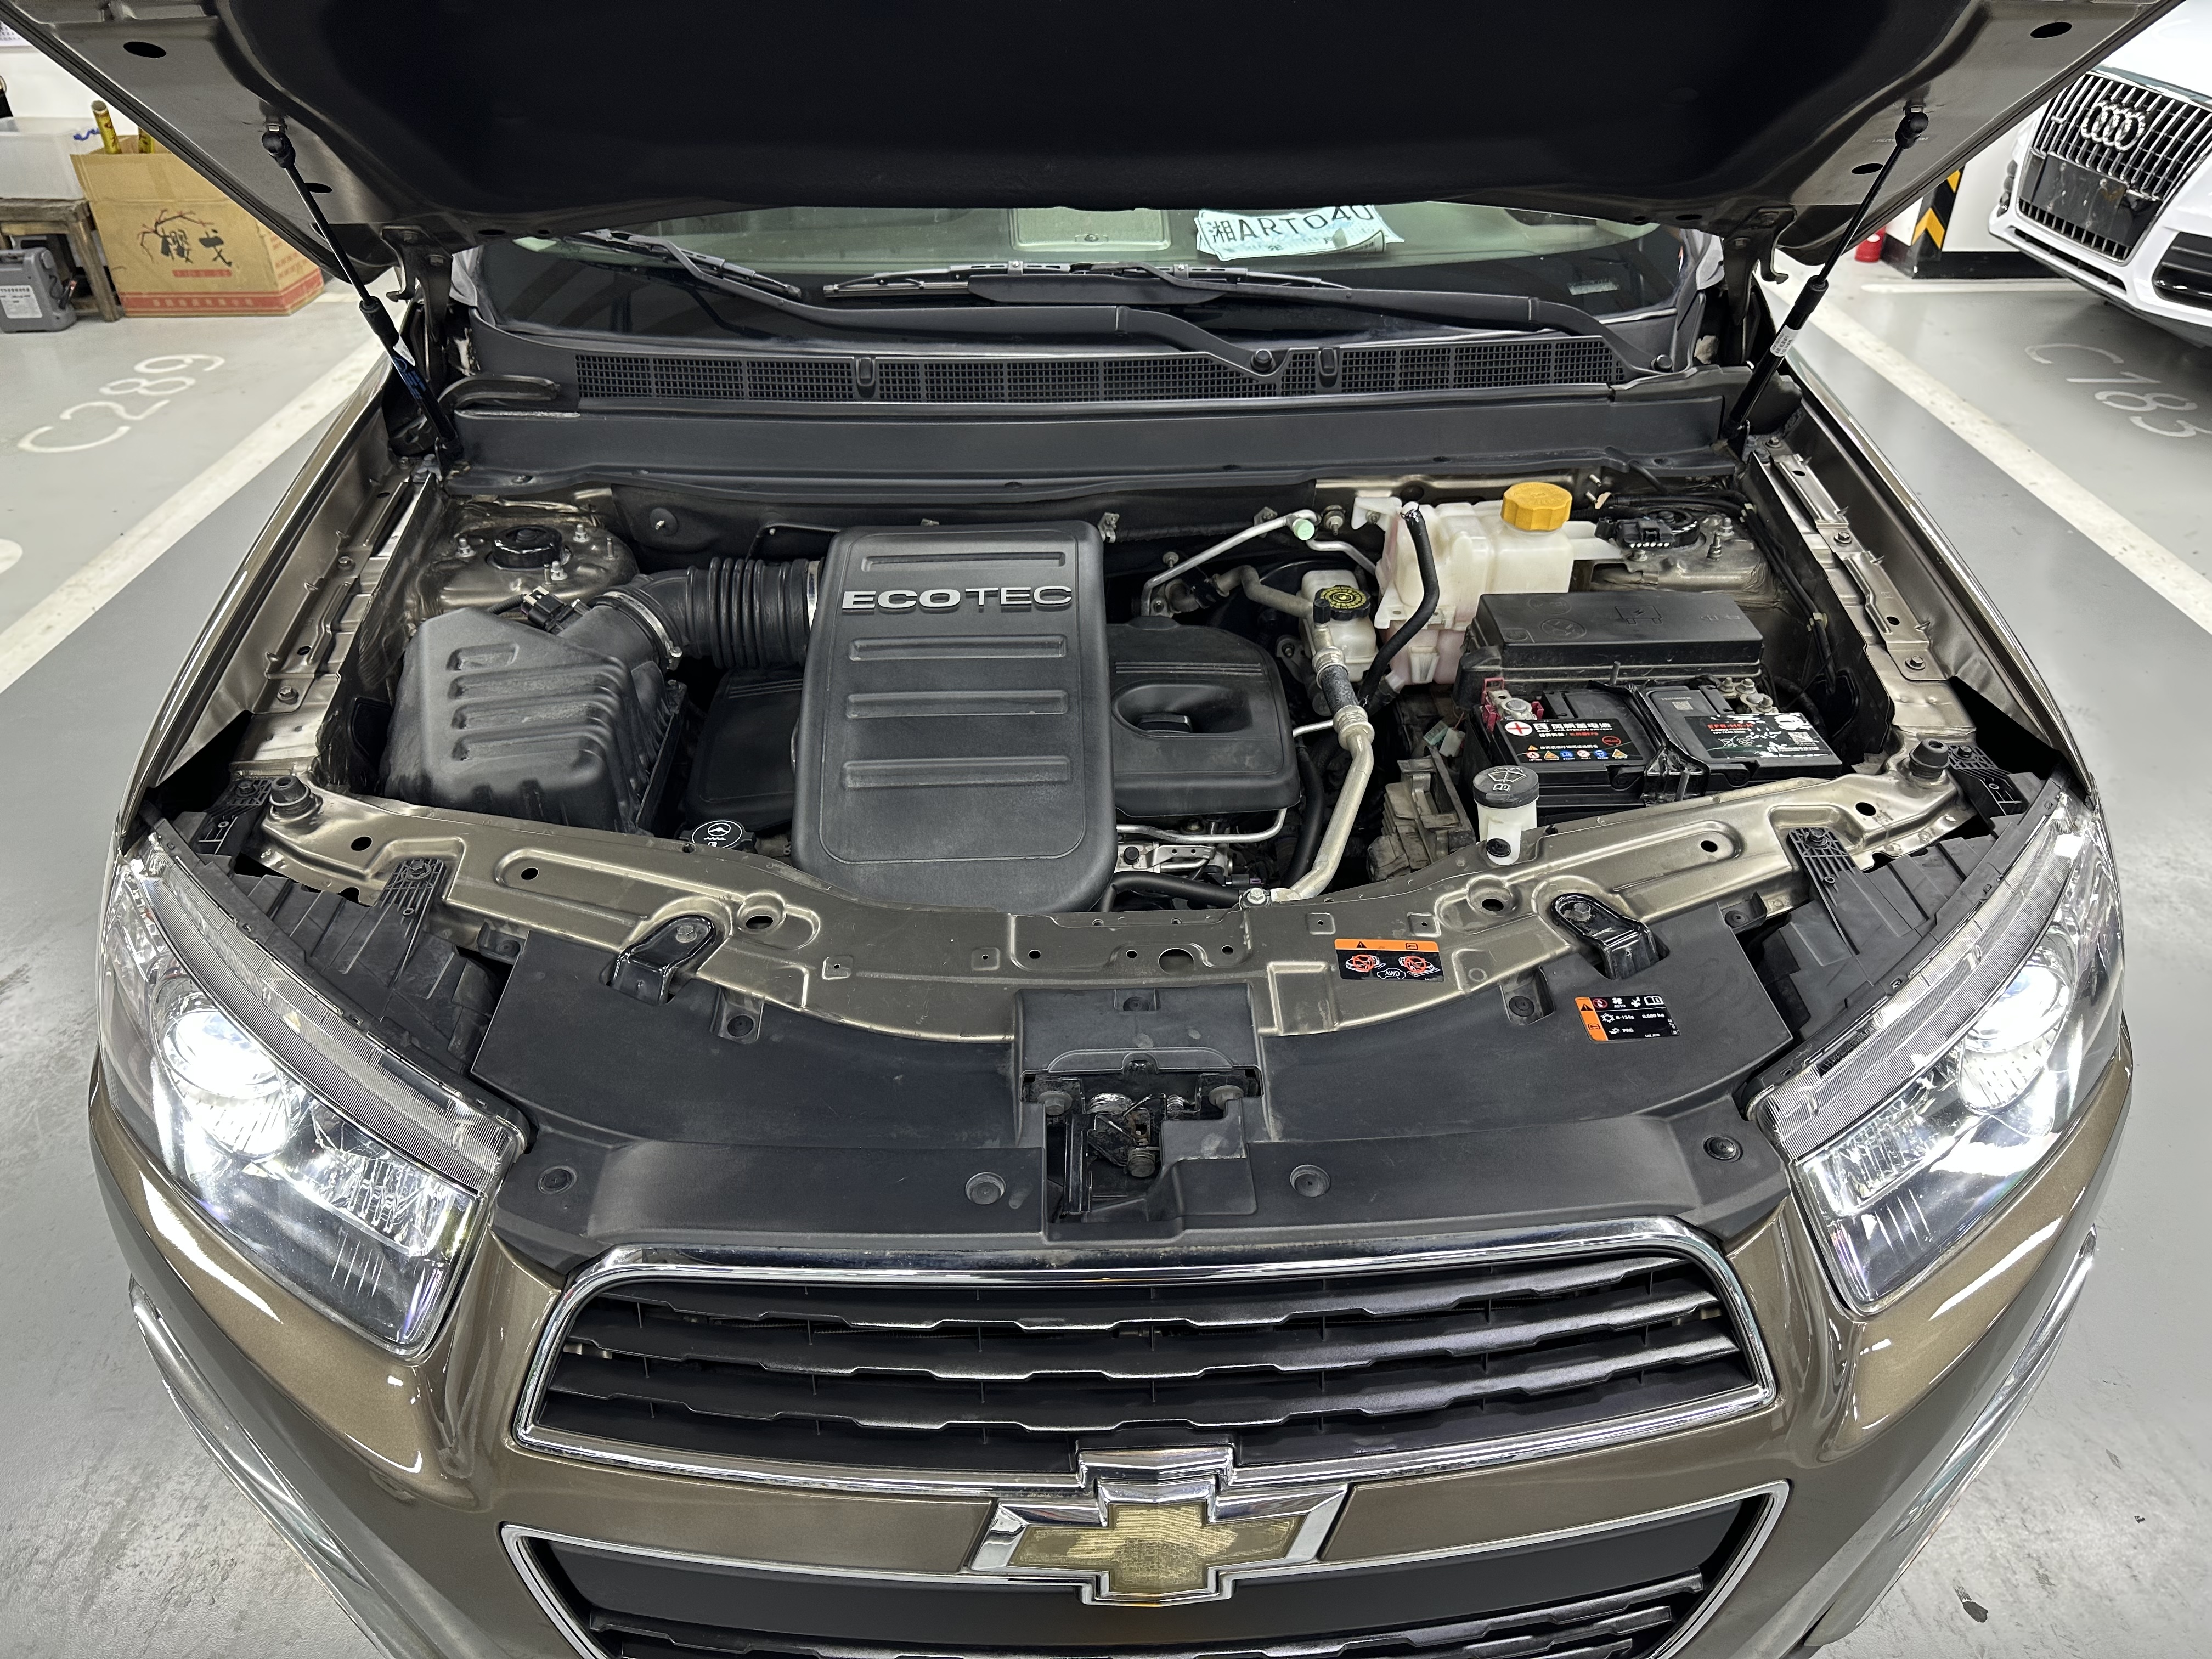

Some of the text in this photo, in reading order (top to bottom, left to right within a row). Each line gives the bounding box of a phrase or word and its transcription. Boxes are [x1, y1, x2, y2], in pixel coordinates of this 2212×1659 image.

[18, 354, 225, 453] C289
[2024, 342, 2212, 437] C183
[842, 585, 1073, 610] ECOTEC
